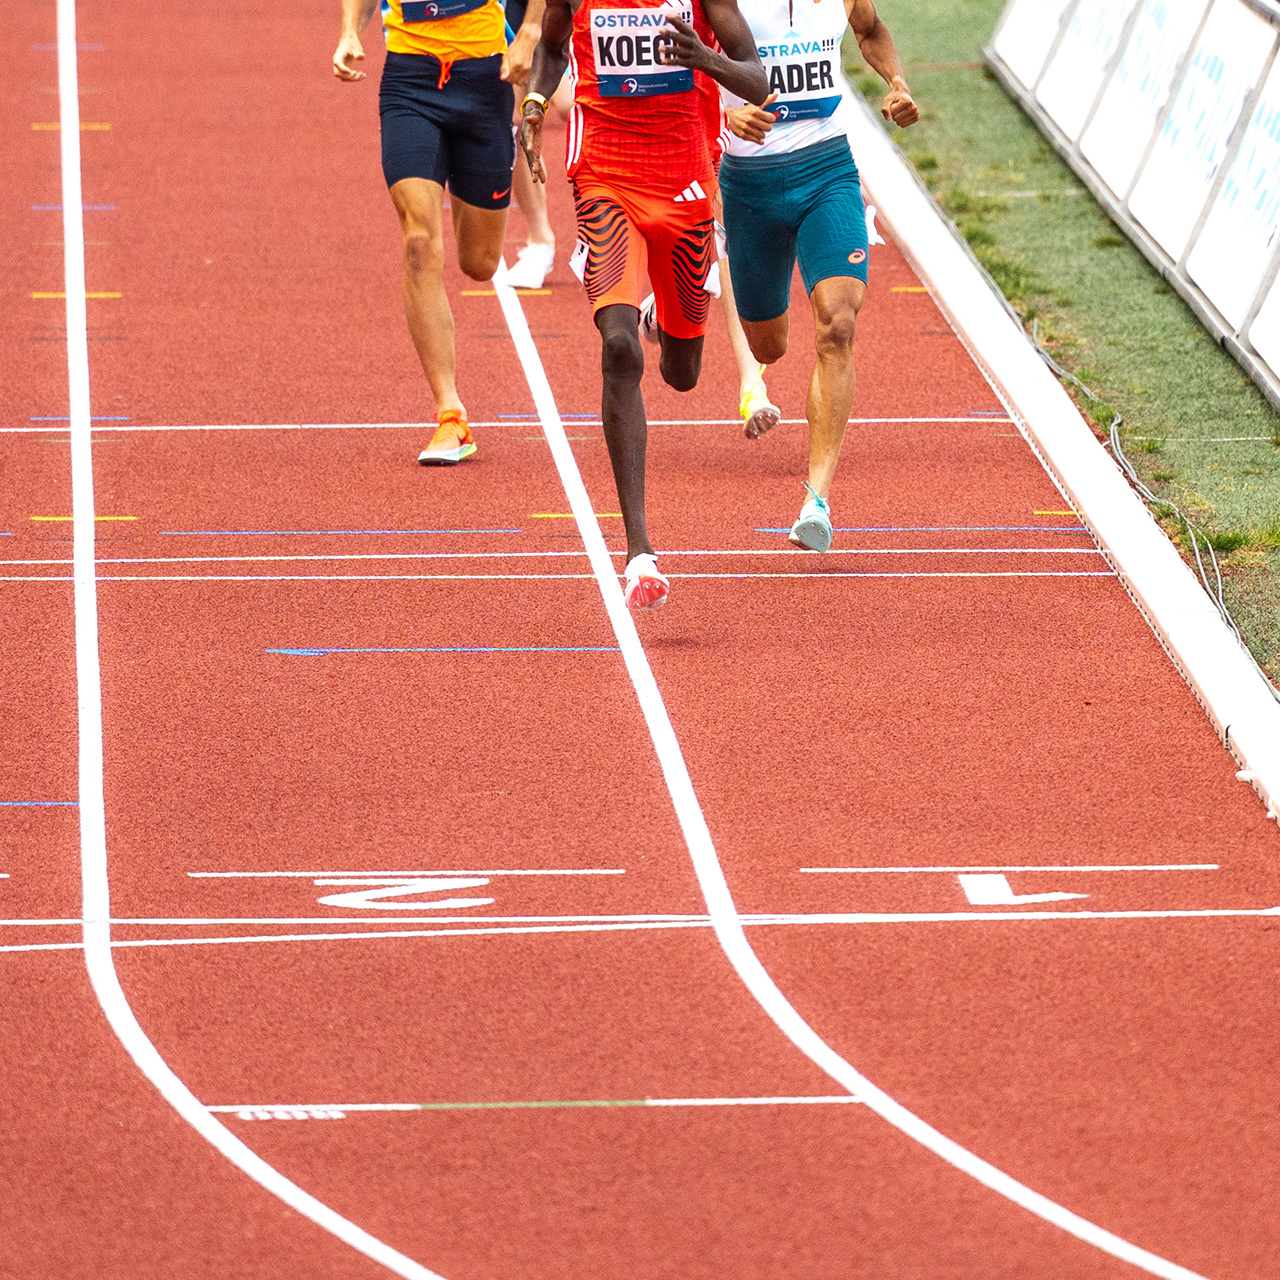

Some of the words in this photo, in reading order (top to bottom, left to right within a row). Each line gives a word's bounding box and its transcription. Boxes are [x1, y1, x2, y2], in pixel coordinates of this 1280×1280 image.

[597, 35, 675, 67] KOEC
[758, 38, 834, 58] STRAVA!!!
[765, 59, 834, 94] ADER
[312, 877, 496, 910] 2
